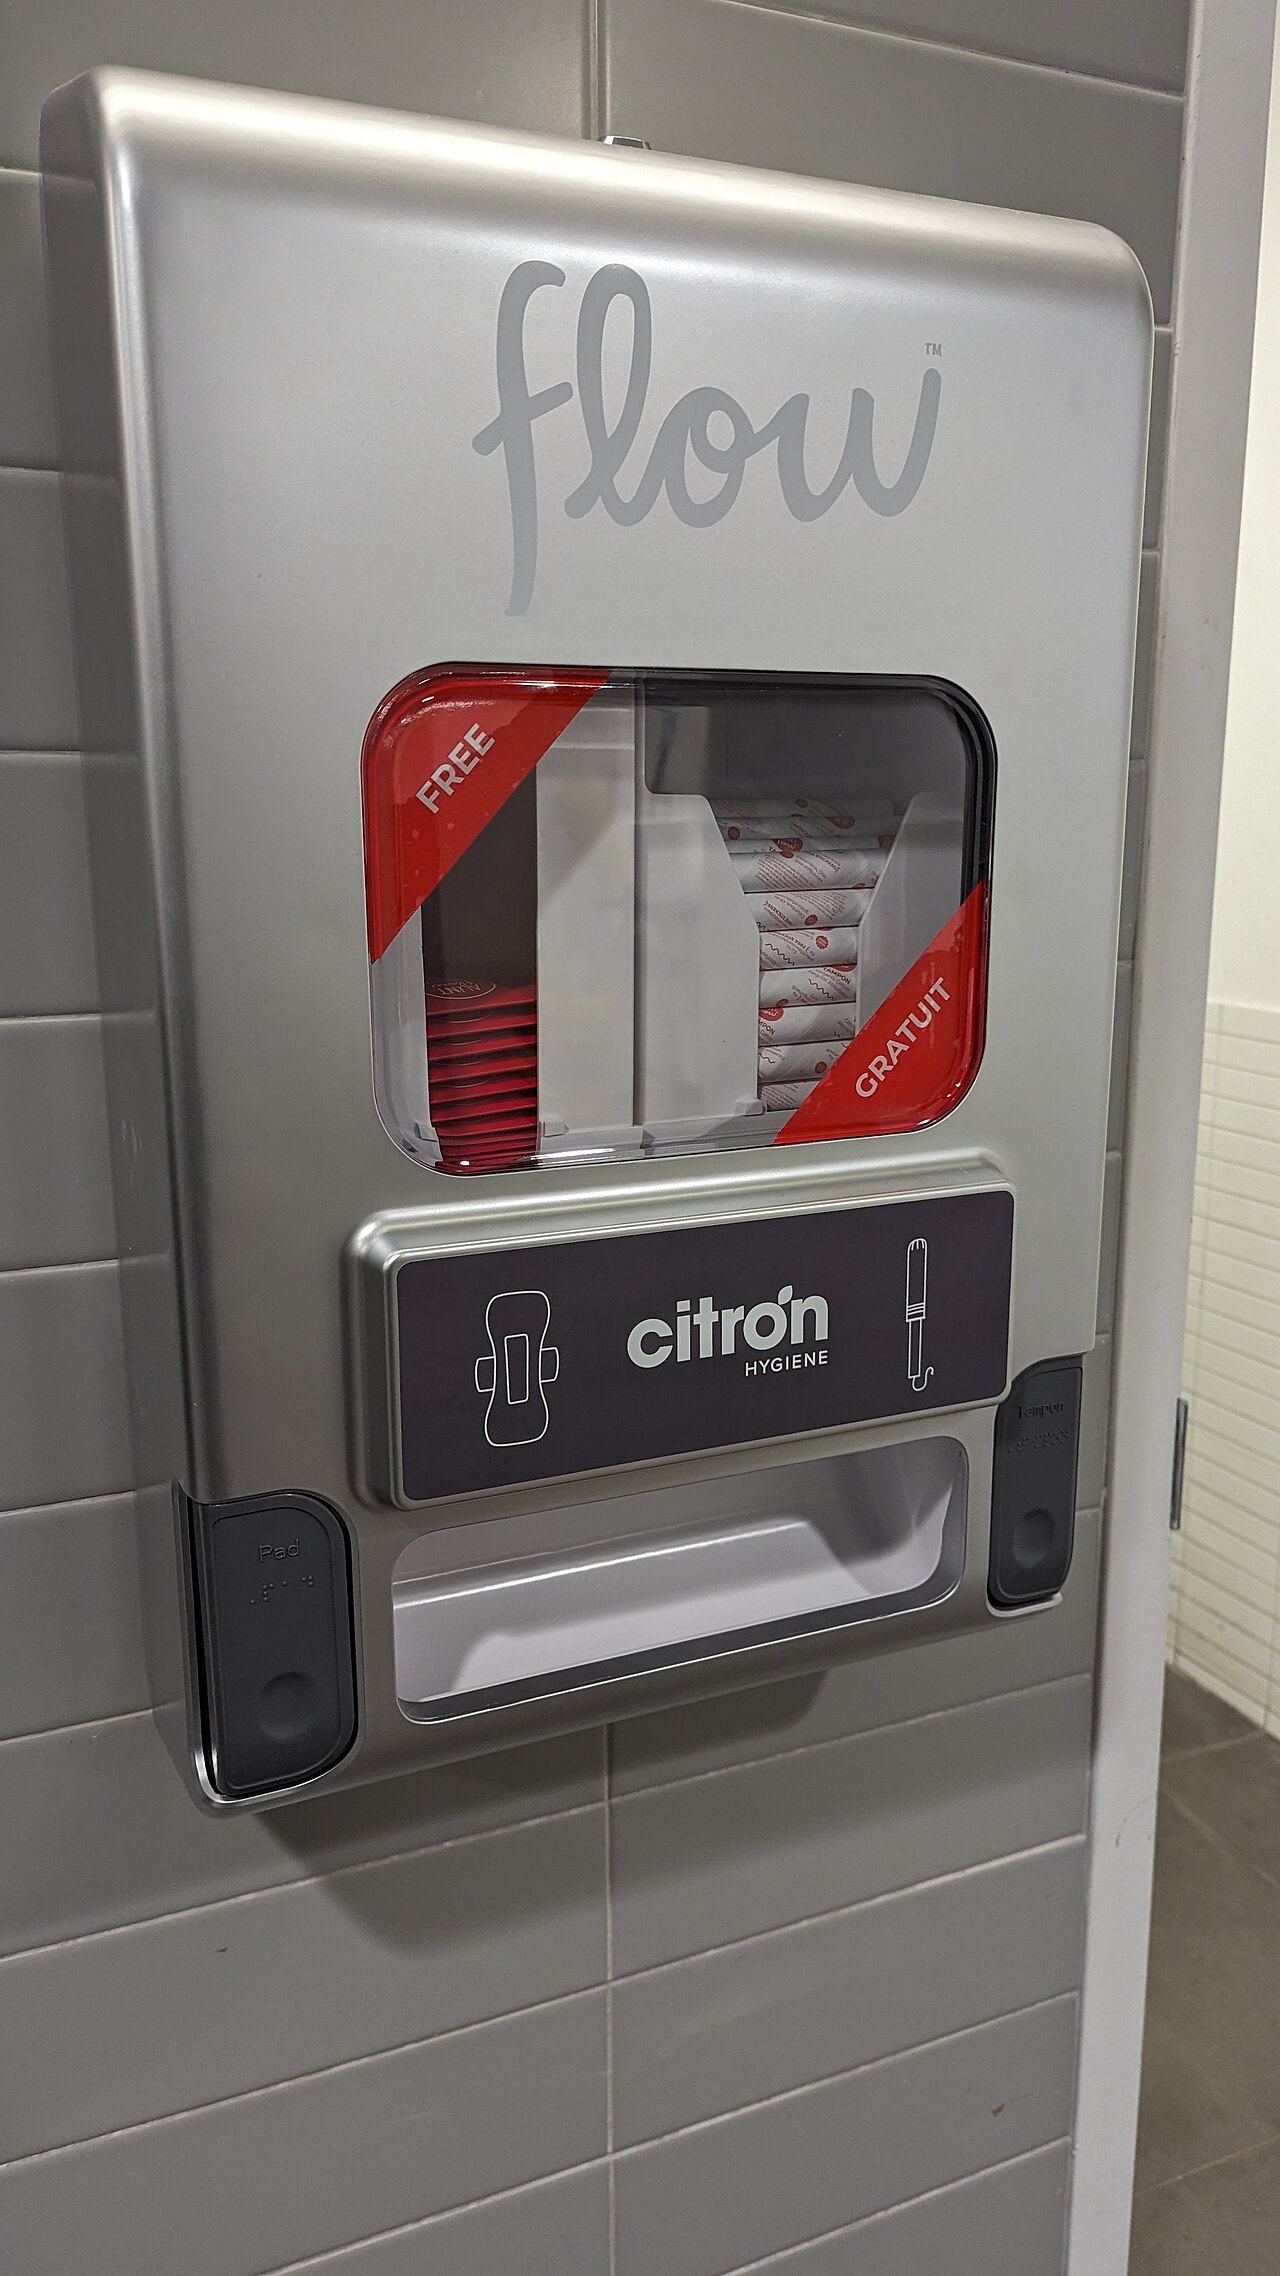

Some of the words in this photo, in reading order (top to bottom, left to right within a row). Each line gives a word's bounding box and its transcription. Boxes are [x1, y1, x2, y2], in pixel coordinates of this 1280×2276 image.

[472, 260, 942, 617] flow
[415, 722, 496, 814] FREE
[855, 976, 951, 1098] GRATUIT
[744, 1350, 829, 1377] HYGIENE
[258, 1539, 301, 1563] Pad
